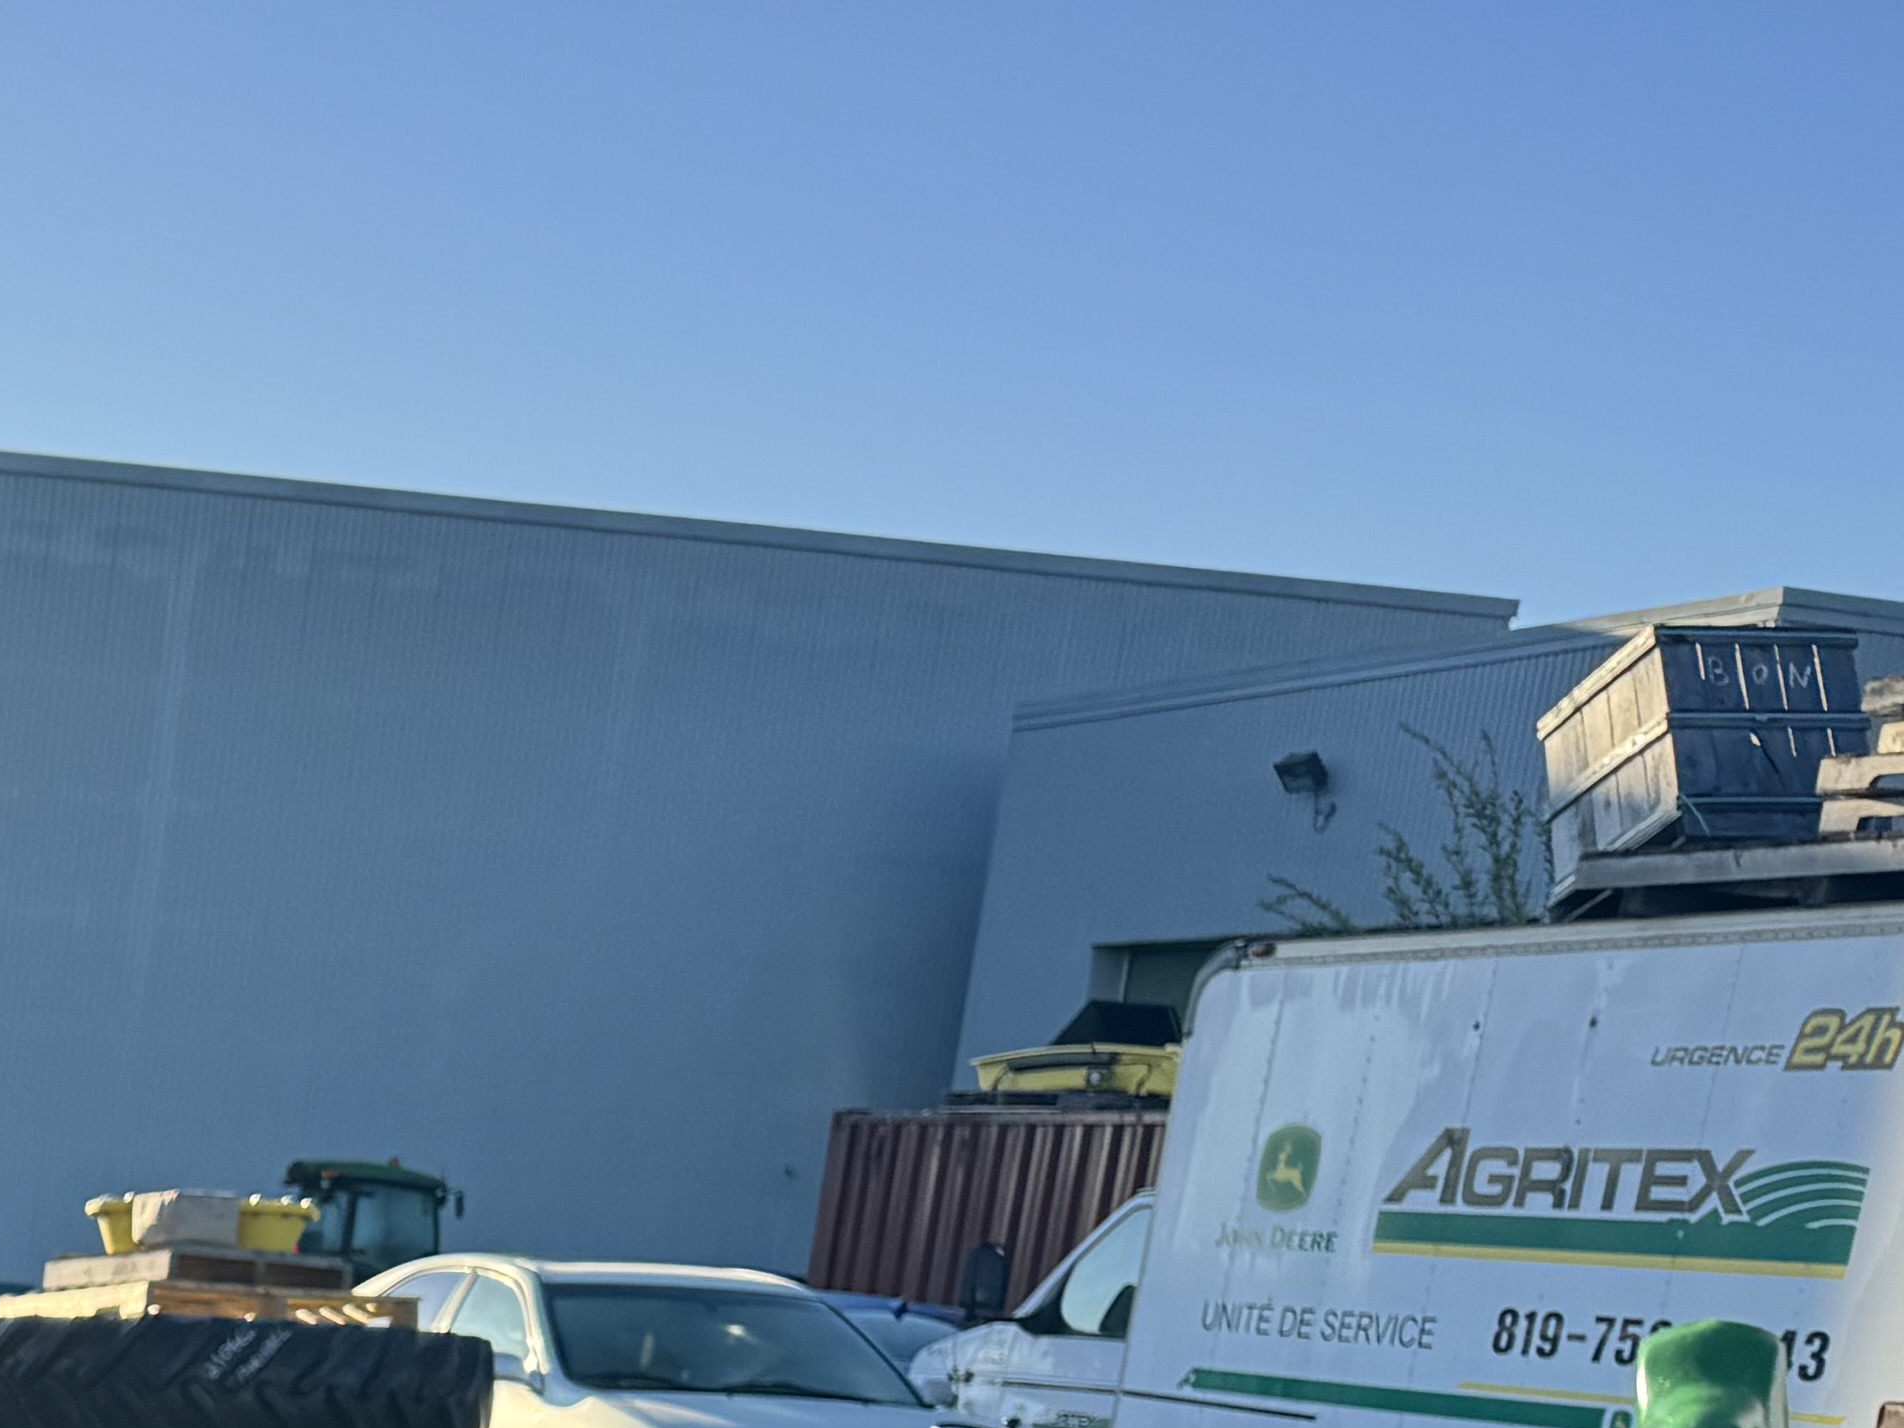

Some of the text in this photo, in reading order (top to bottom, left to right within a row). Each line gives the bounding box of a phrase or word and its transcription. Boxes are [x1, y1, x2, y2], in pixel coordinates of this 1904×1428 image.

[1649, 1006, 1904, 1073] URGENCE 24h
[1382, 1126, 1756, 1217] AGRITEX
[1271, 1225, 1338, 1253] DEERE
[1199, 1296, 1438, 1350] UNITÉ DE SERVICE
